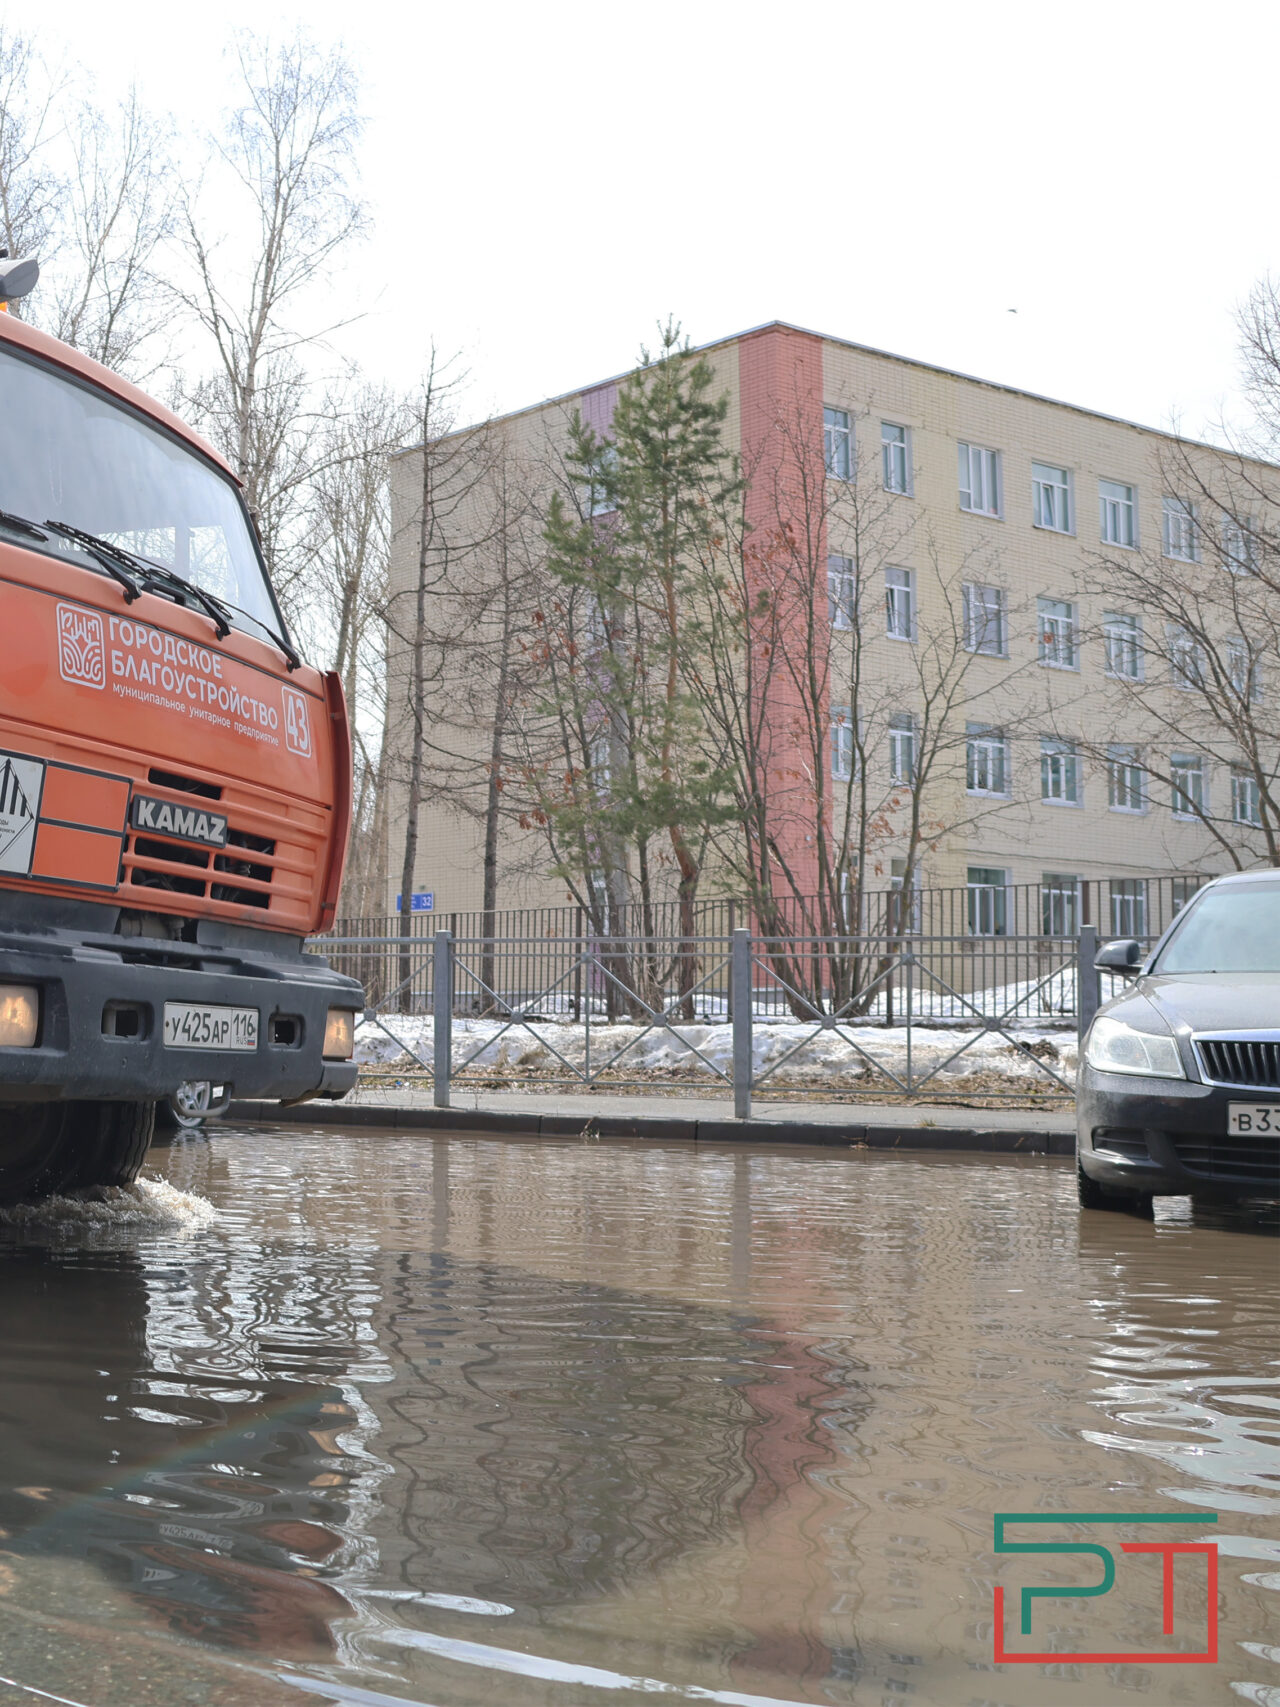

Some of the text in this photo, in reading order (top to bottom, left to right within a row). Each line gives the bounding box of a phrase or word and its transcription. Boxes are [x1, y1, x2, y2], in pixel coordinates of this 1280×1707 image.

[109, 616, 223, 679] ГОРОДСКОЕ
[111, 649, 278, 730] БЛАГОУСТРОЙСТВО
[113, 682, 280, 746] муниципальное унитарное предприятие
[287, 695, 308, 750] 43
[138, 799, 225, 843] KAMAZ
[422, 896, 432, 907] 32
[172, 1011, 254, 1043] У425АР 116
